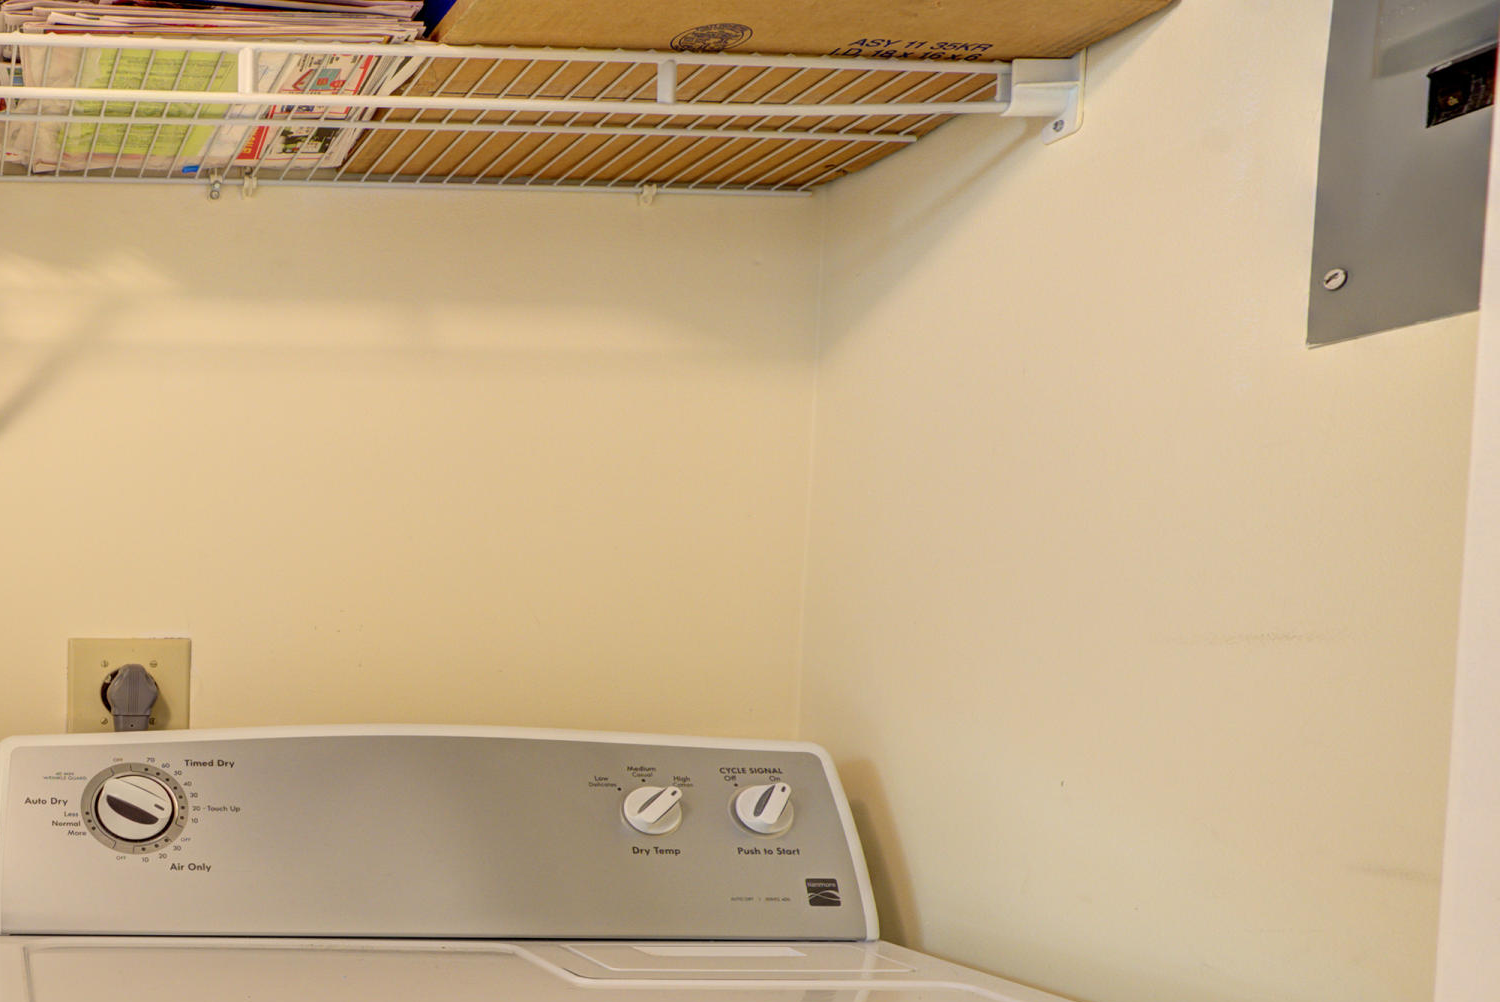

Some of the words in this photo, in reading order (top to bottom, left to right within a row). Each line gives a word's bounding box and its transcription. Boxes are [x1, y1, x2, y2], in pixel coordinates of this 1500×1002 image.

[848, 38, 902, 48] ASY
[870, 49, 898, 58] 18
[918, 51, 946, 59] 16
[963, 53, 983, 61] 6
[184, 759, 214, 768] Timed
[216, 759, 235, 769] Dry
[749, 767, 783, 775] SIGNAL
[24, 797, 47, 806] Auto
[50, 797, 68, 807] Dry
[230, 805, 241, 814] Up
[51, 820, 81, 828] Normal
[632, 847, 651, 857] Dry
[653, 846, 681, 856] Temp
[737, 847, 761, 856] Push
[763, 847, 774, 856] to
[776, 847, 800, 856] Start
[170, 863, 186, 871] Air
[187, 862, 212, 873] Only
